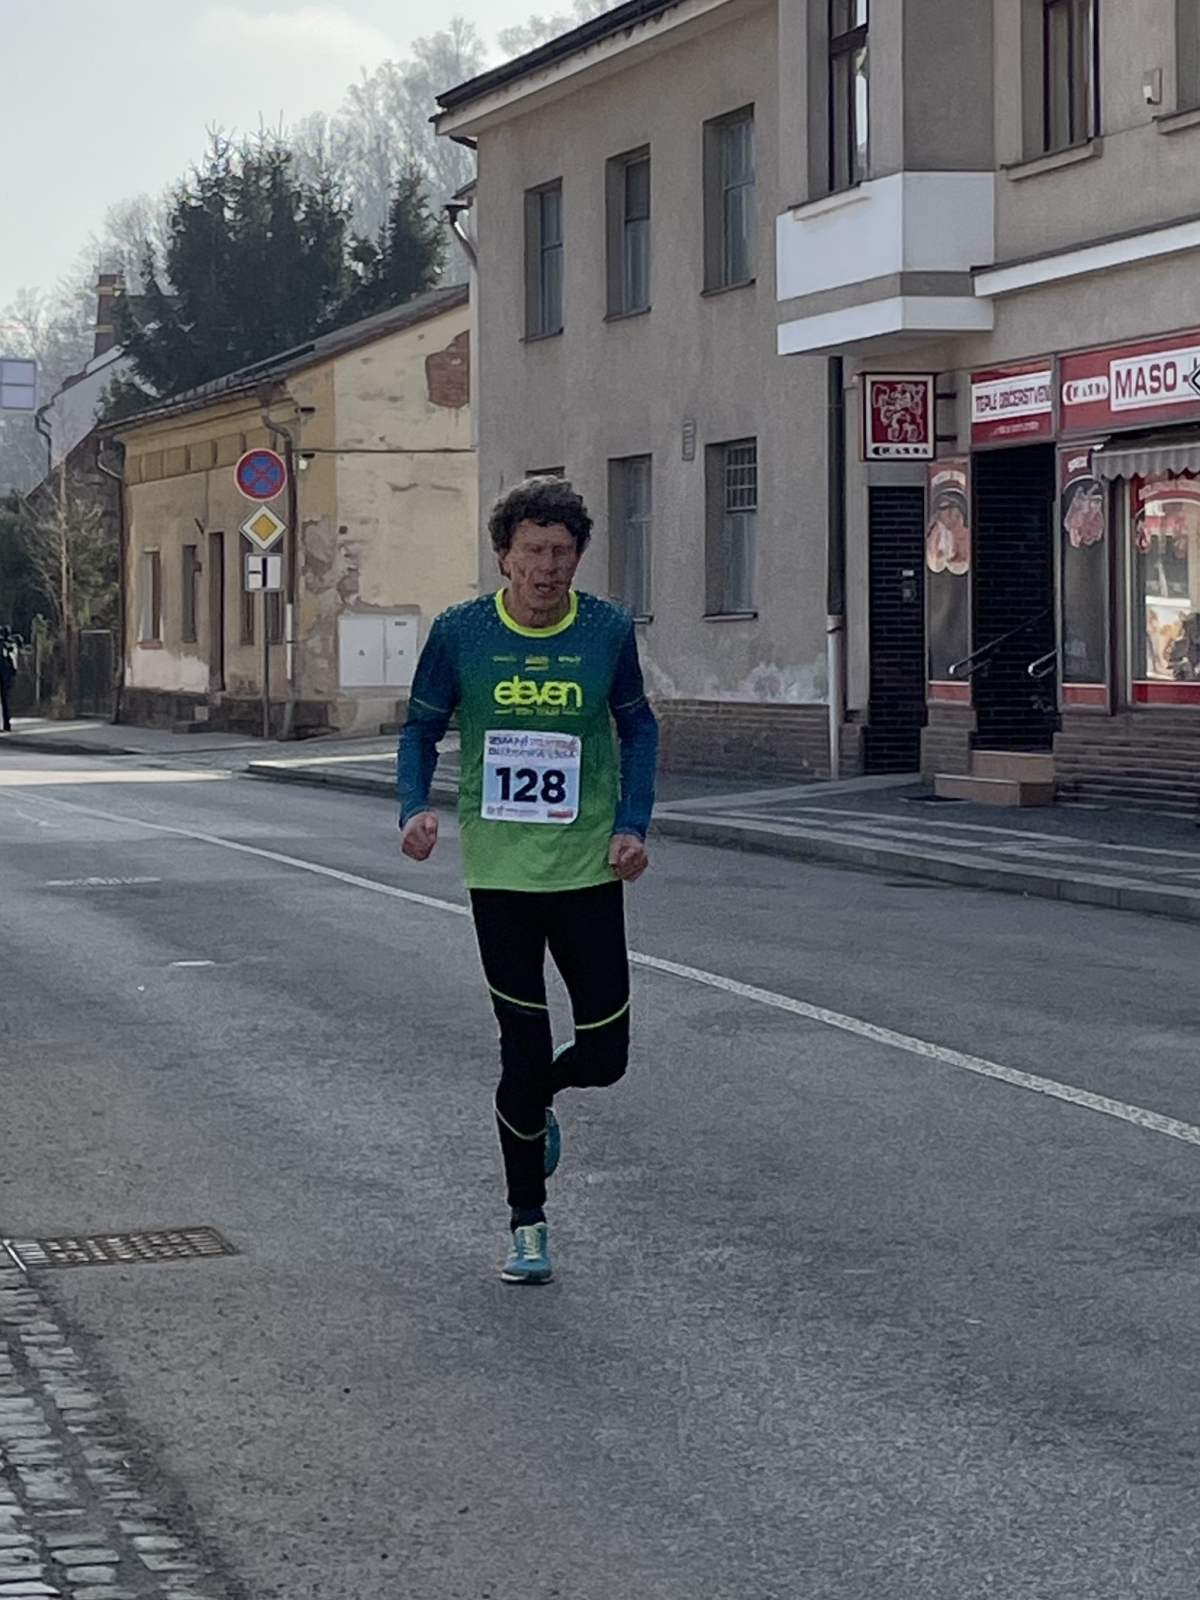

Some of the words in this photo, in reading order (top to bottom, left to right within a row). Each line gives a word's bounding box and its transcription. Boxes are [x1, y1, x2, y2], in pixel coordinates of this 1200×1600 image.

[1115, 361, 1177, 400] MASO
[494, 675, 583, 708] eleven
[495, 767, 566, 804] 128
